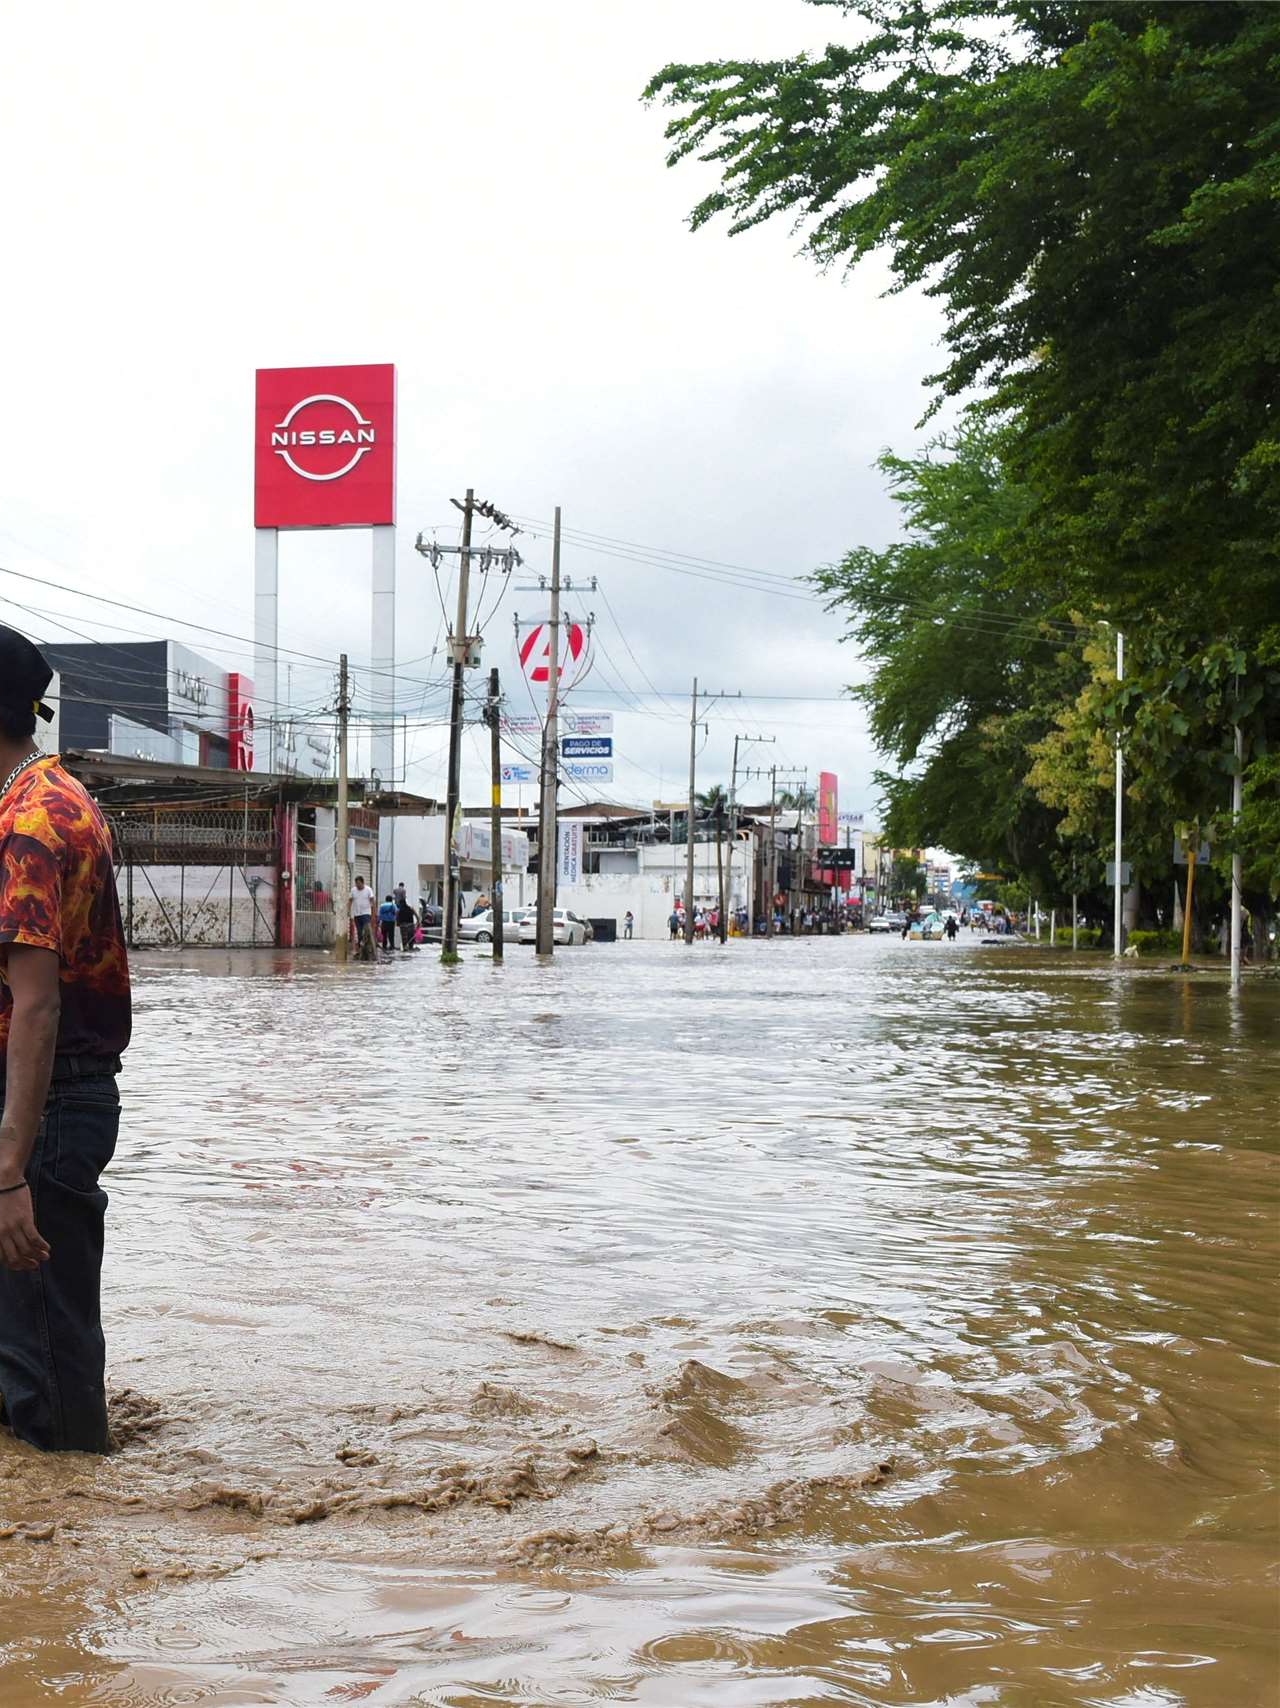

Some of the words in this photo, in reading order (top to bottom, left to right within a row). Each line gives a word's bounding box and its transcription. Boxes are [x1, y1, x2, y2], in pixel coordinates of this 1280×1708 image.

[272, 429, 375, 446] NISSAN
[564, 747, 609, 755] SERVICIOS
[567, 763, 608, 775] derma
